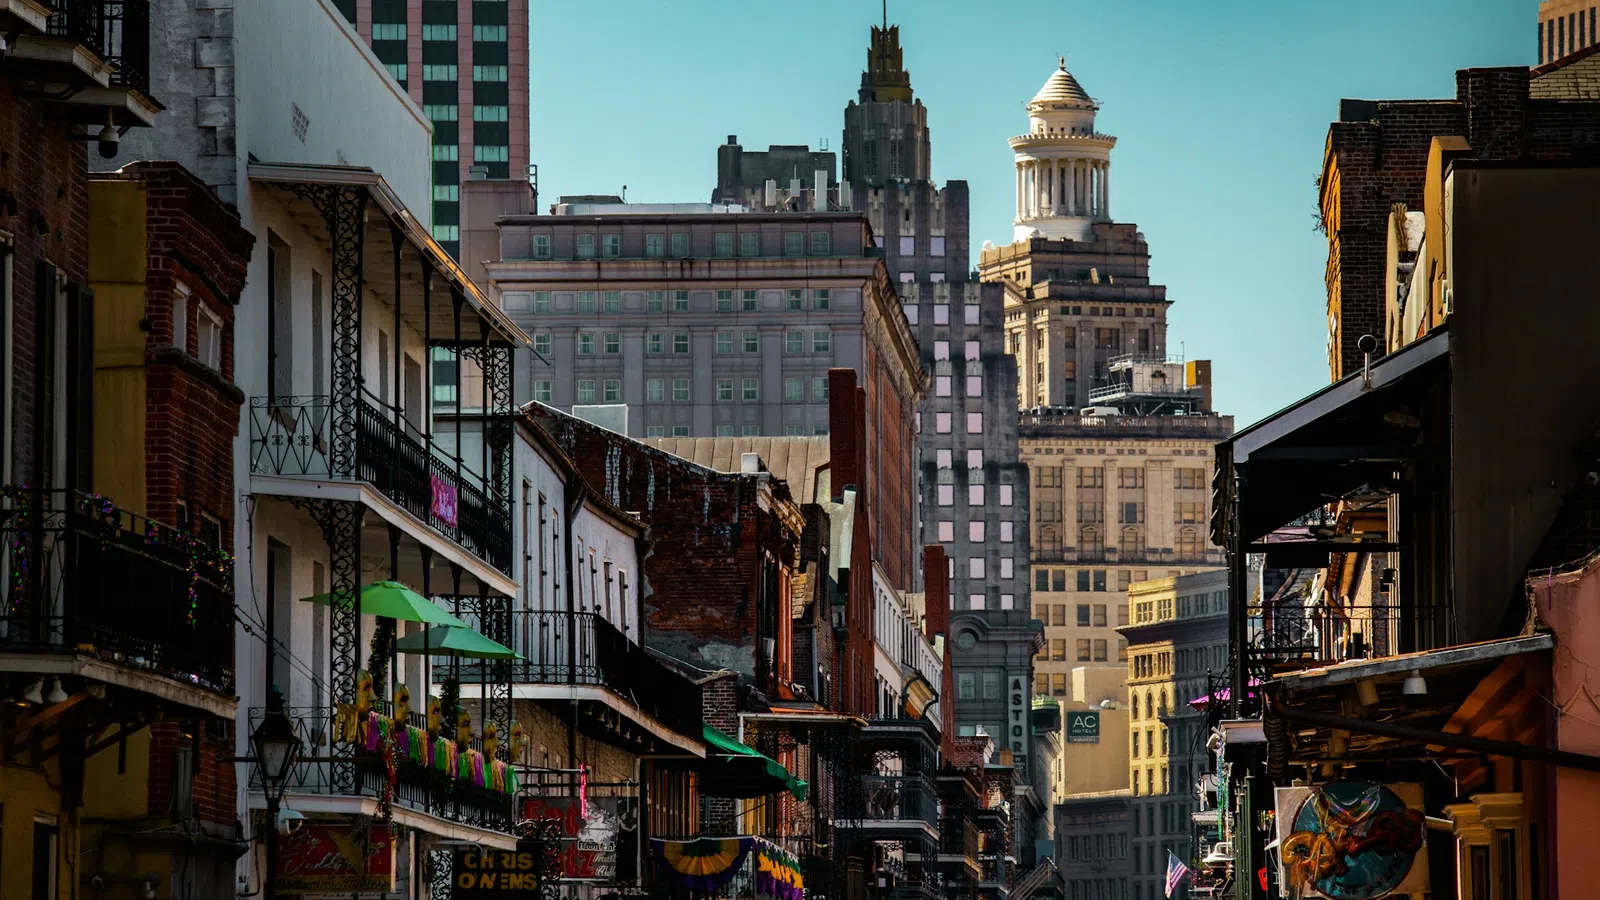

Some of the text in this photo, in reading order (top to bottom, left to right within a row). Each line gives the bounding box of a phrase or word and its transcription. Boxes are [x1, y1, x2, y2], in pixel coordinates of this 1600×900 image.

[1012, 679, 1023, 753] ASTOR
[1072, 715, 1097, 728] AC
[463, 852, 534, 871] CHRIS
[457, 872, 537, 890] OWENS
